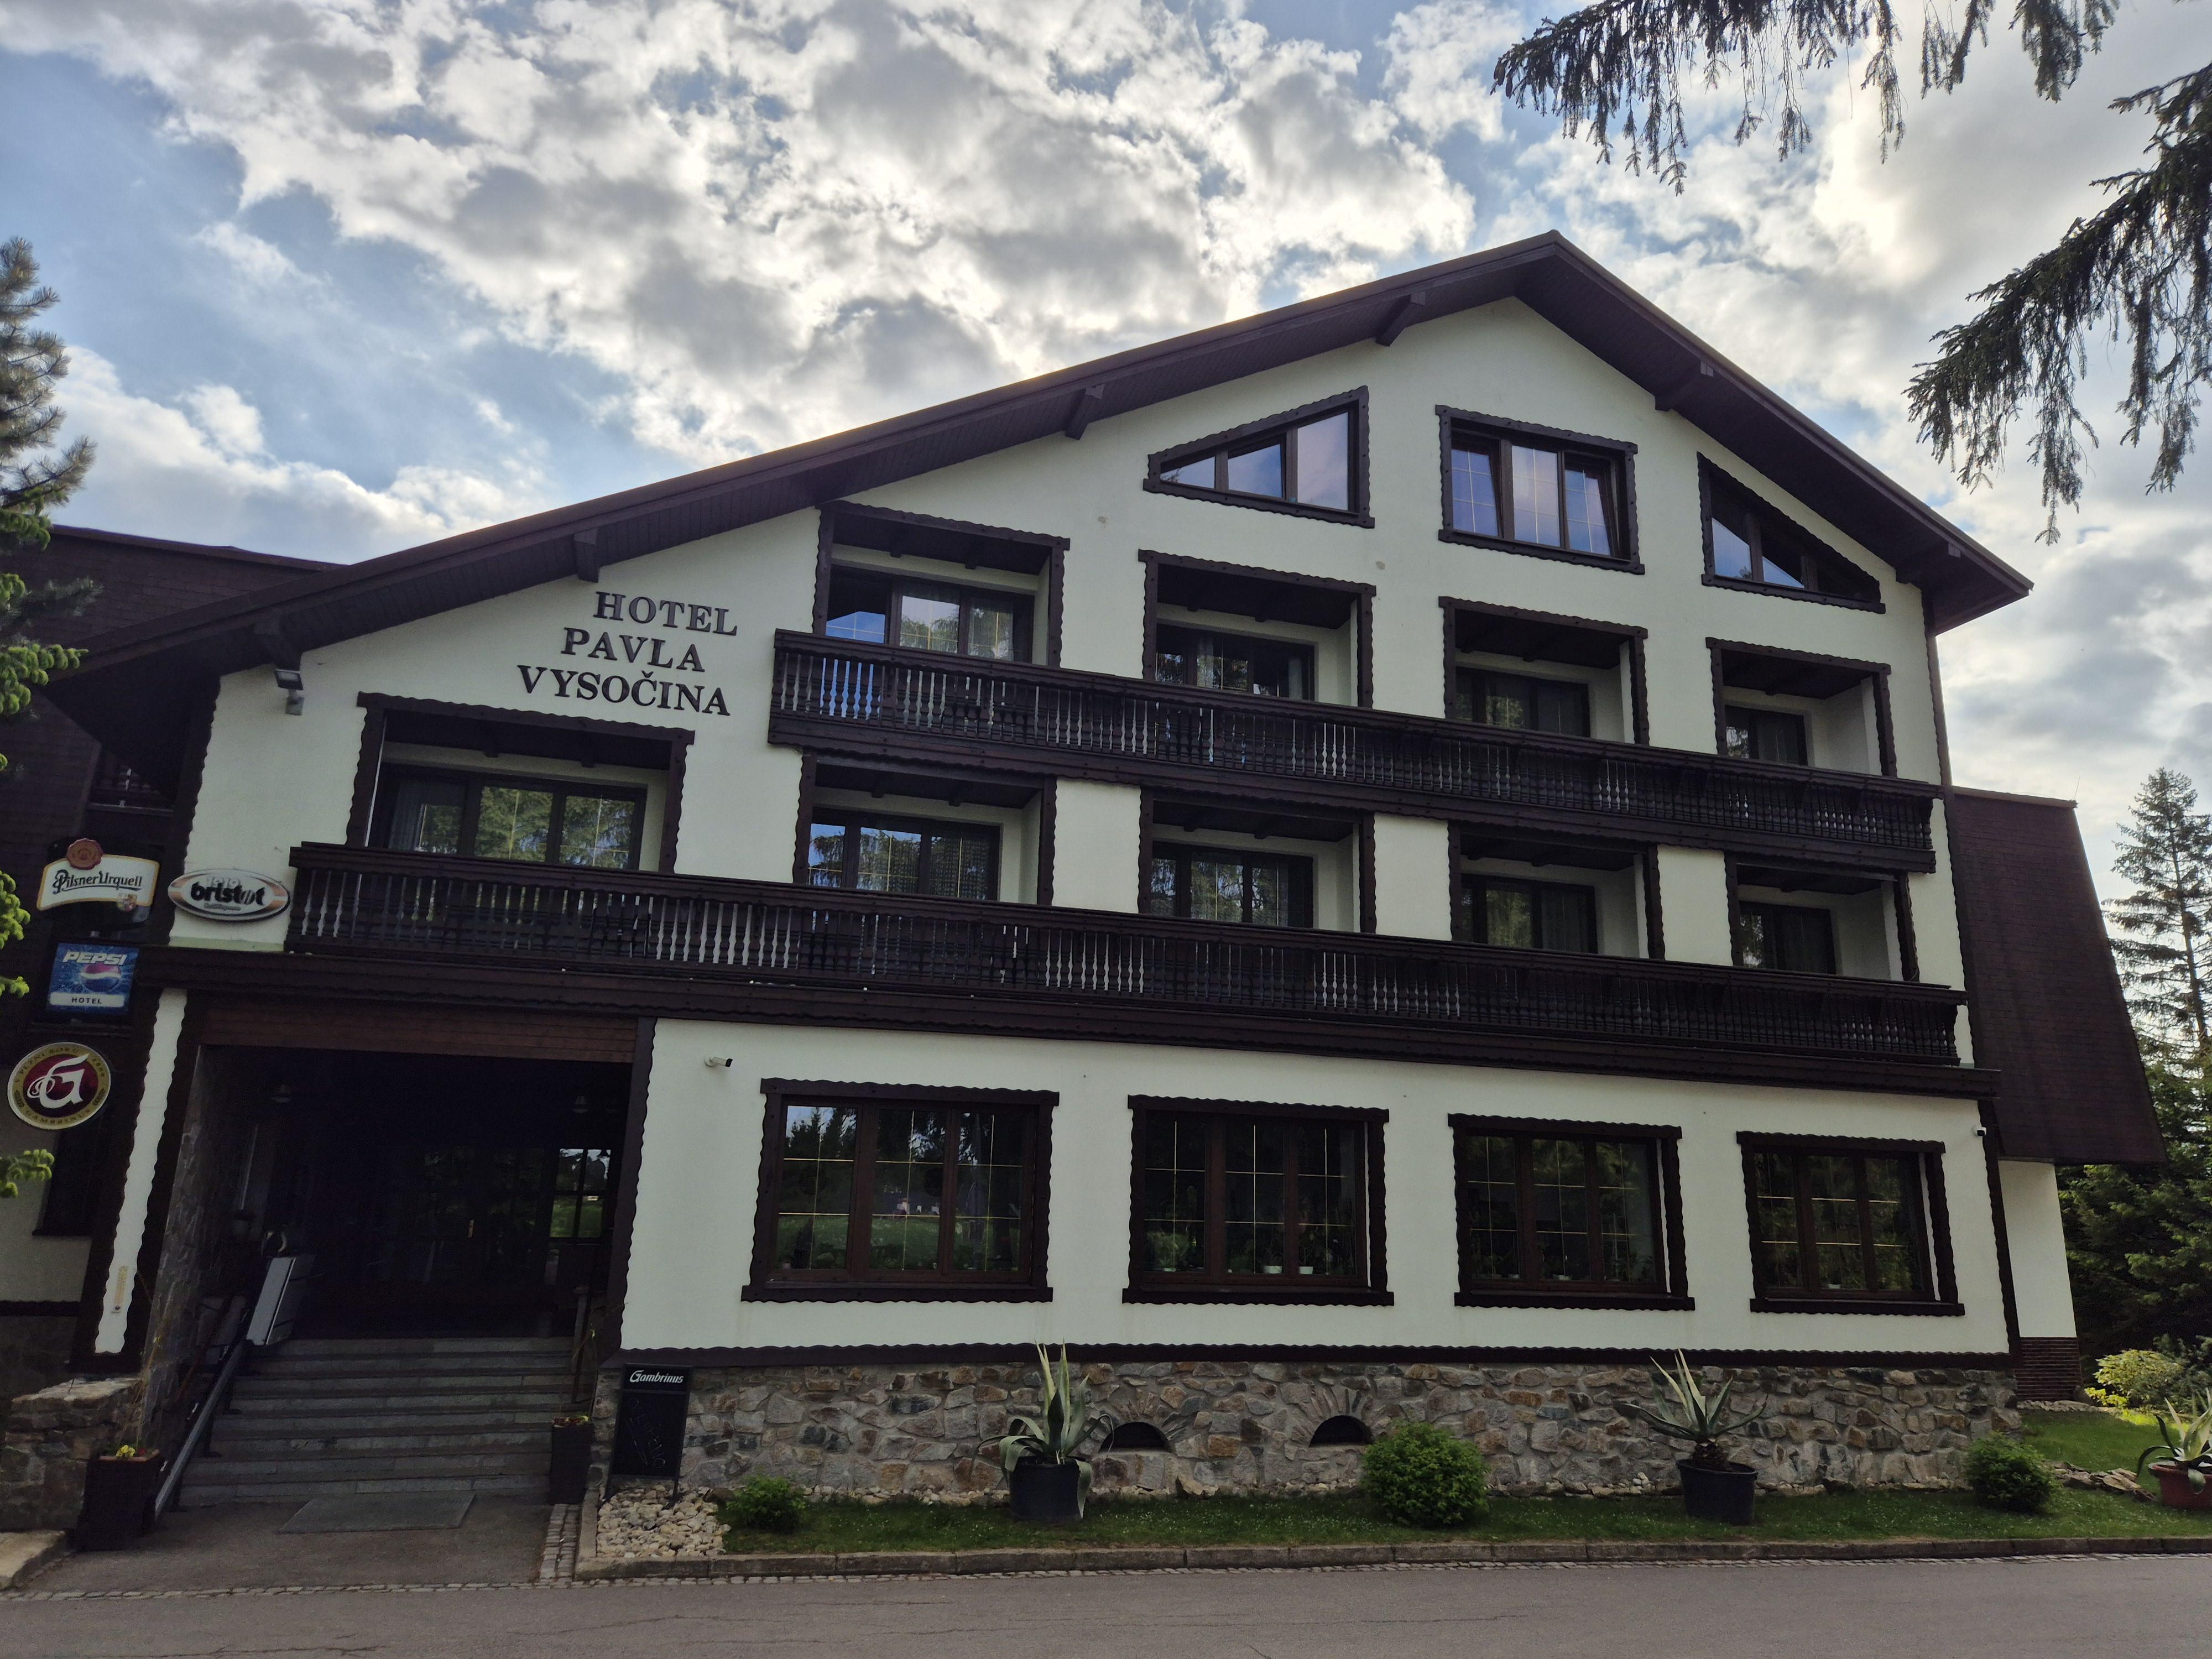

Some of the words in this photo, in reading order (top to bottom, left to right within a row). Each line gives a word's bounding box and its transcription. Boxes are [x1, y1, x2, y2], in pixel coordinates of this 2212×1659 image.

[593, 591, 738, 637] HOTEL
[560, 627, 705, 672] PAVLA
[517, 665, 731, 716] VYSOČINA
[52, 869, 100, 895] Pilsner
[98, 870, 143, 890] Urquell
[190, 881, 265, 906] bristot
[62, 950, 128, 966] PEPSI
[629, 1369, 685, 1384] Gambrinus
